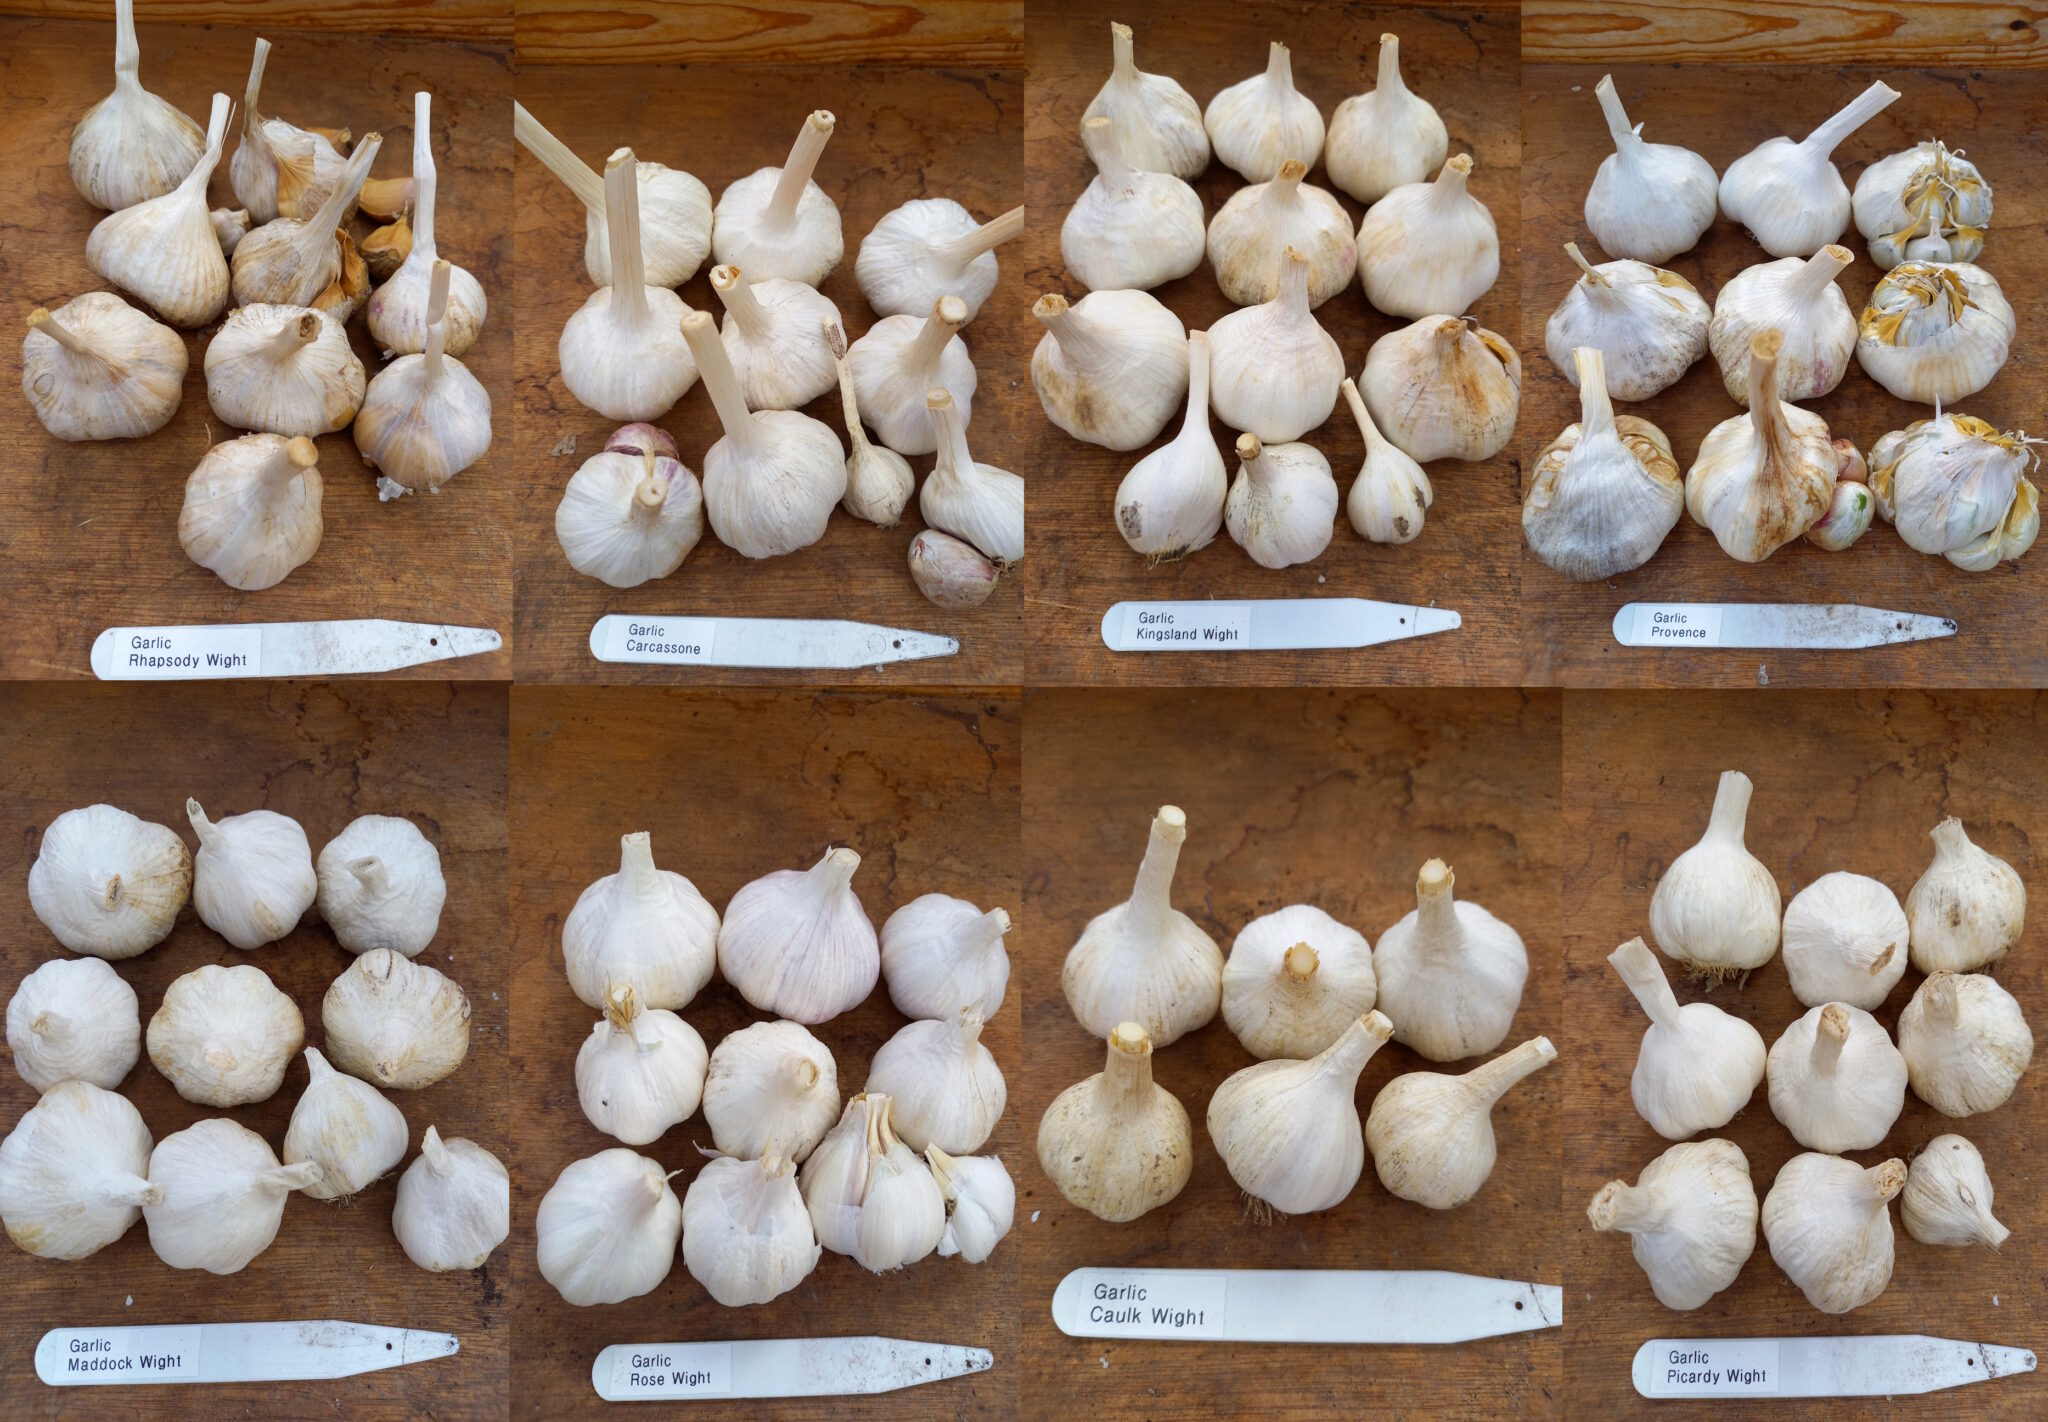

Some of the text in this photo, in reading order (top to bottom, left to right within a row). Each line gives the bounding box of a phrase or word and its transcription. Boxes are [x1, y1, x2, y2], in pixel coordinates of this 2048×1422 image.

[1138, 611, 1175, 625] Garlic
[1653, 611, 1688, 624] Garlic
[628, 623, 665, 637] Garlic
[1136, 627, 1238, 642] Kingsland Wight
[1651, 626, 1707, 639] Provence
[131, 635, 172, 650] Garlic
[626, 638, 701, 655] Carcassone
[128, 652, 247, 669] Rhapsody Wight
[1093, 1282, 1148, 1302] Garlic
[1090, 1305, 1205, 1328] Caulk Wight
[69, 1338, 112, 1353] Garlic
[68, 1353, 182, 1372] Maddock Wight
[631, 1353, 672, 1369] Garlic
[1668, 1350, 1709, 1365] Garlic
[630, 1370, 711, 1387] Rose Wight
[1667, 1368, 1766, 1386] Picardy Wight
